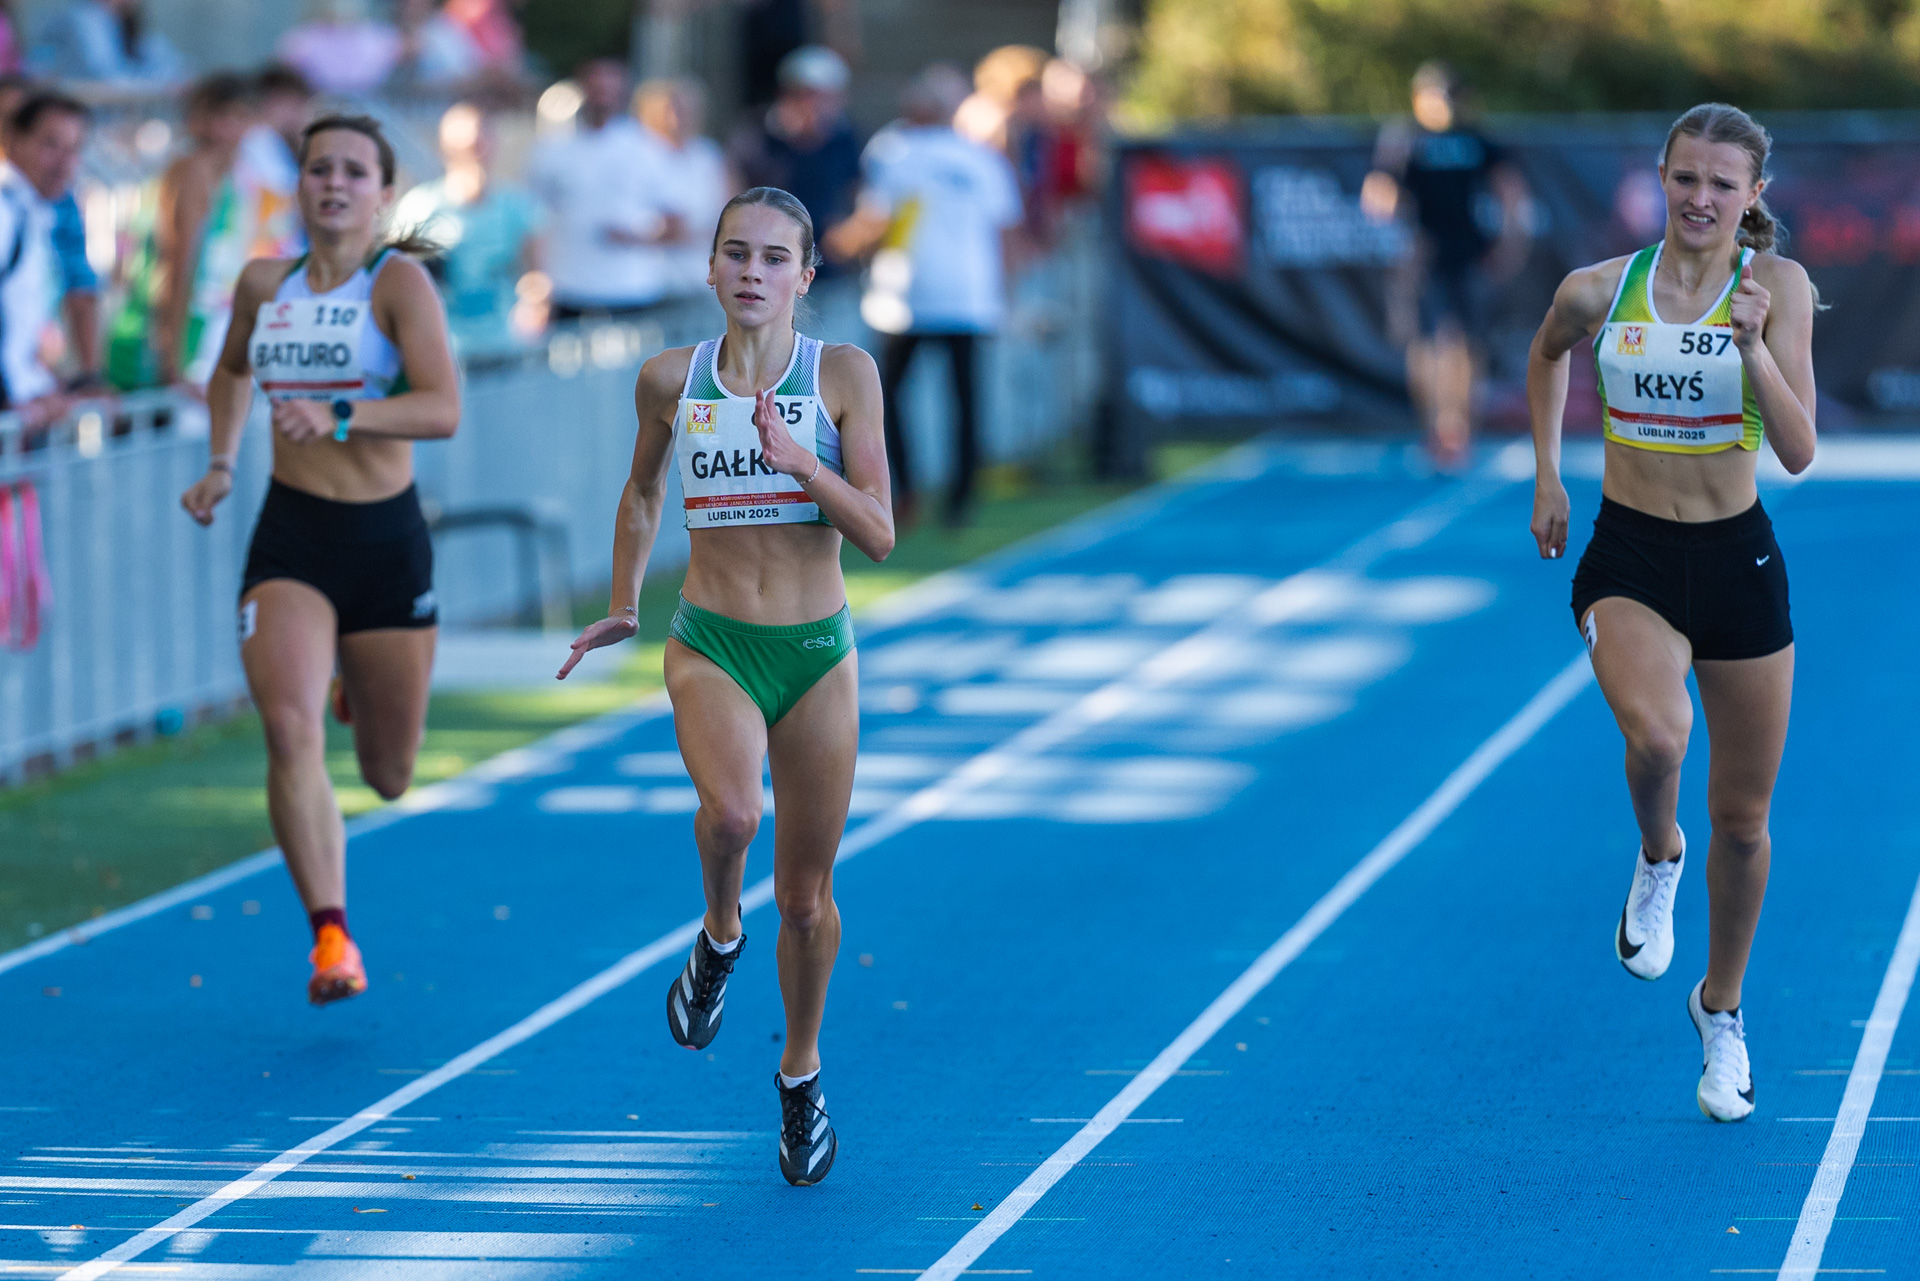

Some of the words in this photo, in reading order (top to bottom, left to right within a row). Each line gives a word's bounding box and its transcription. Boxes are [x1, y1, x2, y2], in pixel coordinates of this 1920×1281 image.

[314, 305, 357, 326] 110
[256, 342, 351, 368] BATURO
[1680, 331, 1732, 356] 587
[1634, 371, 1704, 402] KŁYŚ
[1638, 426, 1675, 439] LUBLIN
[1678, 430, 1706, 440] 2025
[691, 448, 778, 480] GAŁK
[707, 510, 746, 521] LUBLIN
[748, 507, 779, 519] 2025
[803, 635, 836, 649] esa
